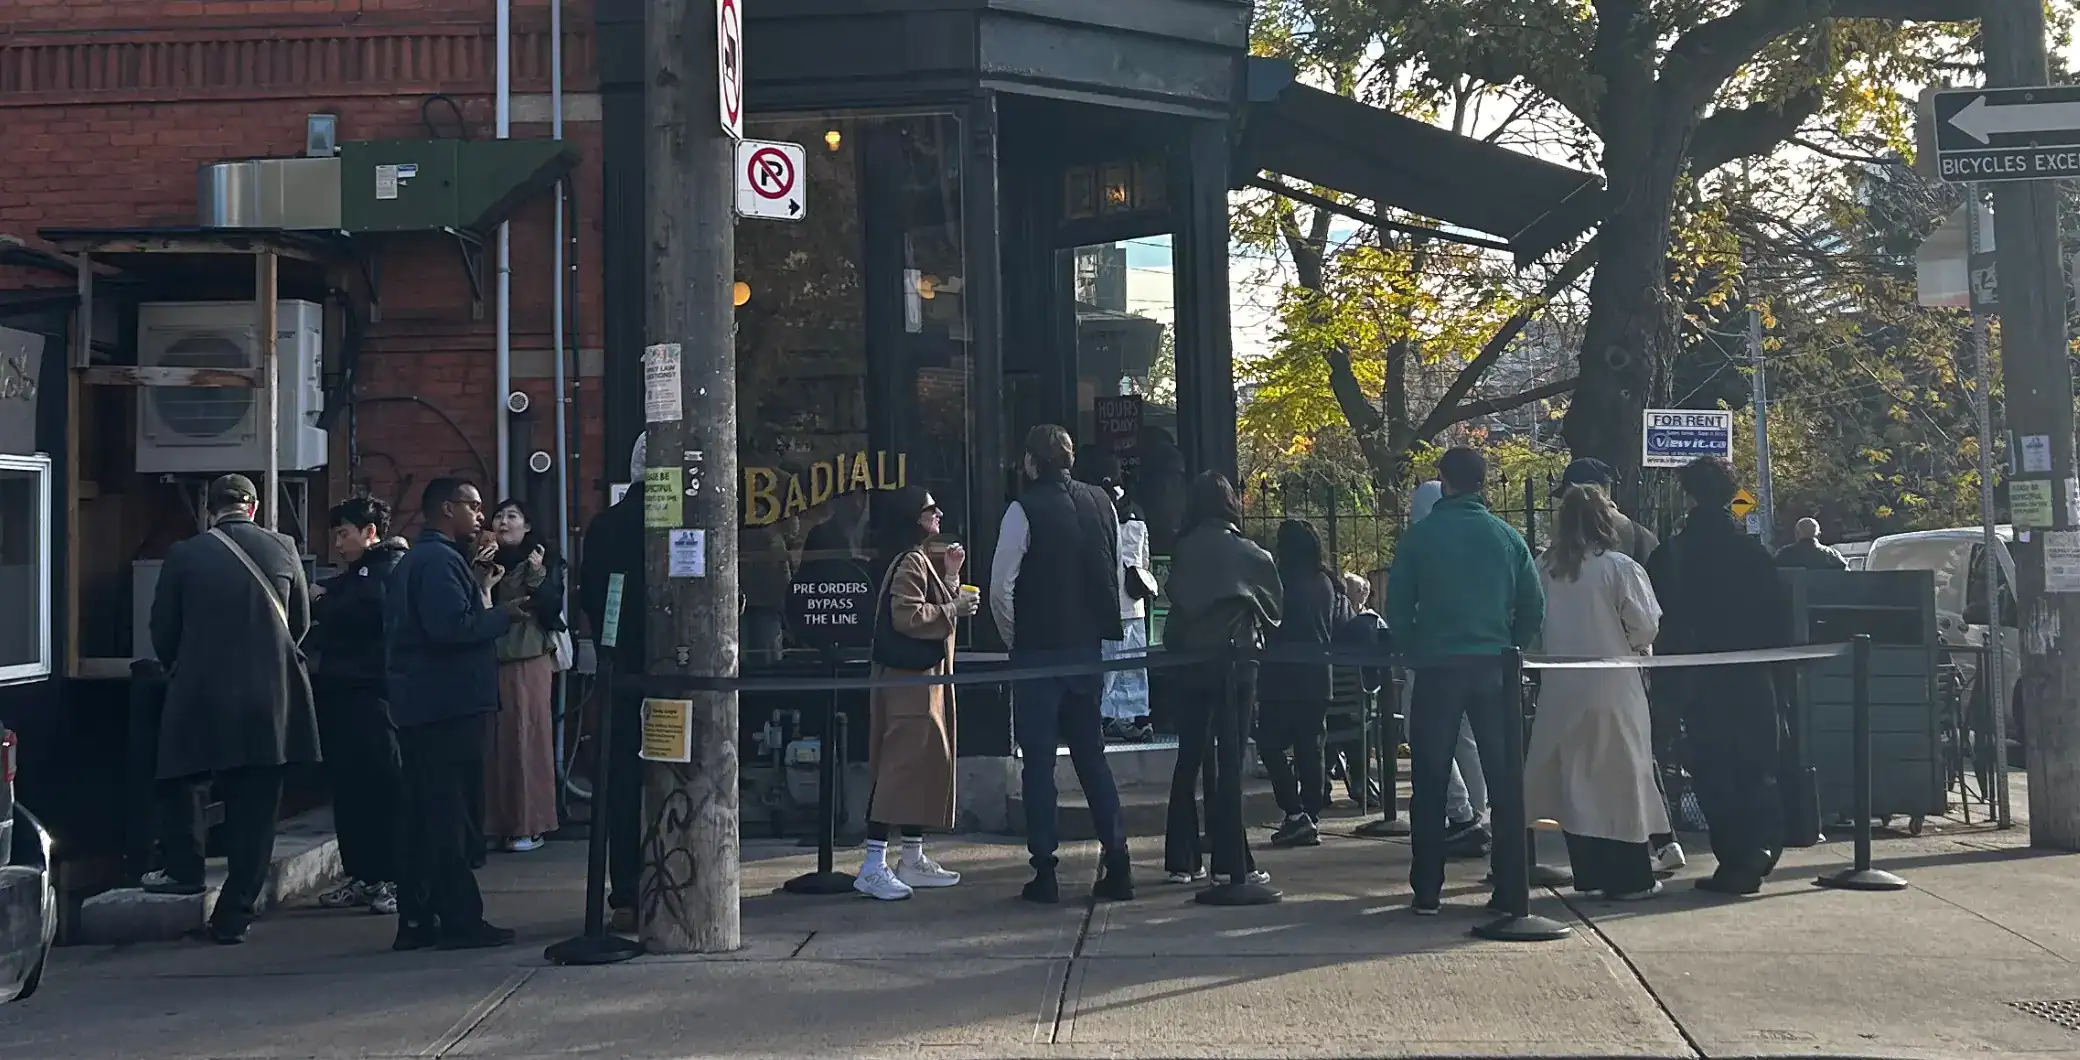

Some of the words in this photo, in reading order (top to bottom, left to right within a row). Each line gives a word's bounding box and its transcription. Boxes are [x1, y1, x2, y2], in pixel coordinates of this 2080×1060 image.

[1942, 155, 2027, 175] BICYCLES
[2035, 152, 2080, 171] EXCE
[1099, 400, 1139, 420] HOURS
[1100, 420, 1109, 433] 7
[1654, 414, 1682, 428] FOR
[1686, 415, 1724, 428] RENT
[744, 450, 907, 526] BADIALI
[793, 583, 816, 594] PRE
[818, 582, 868, 594] ORDERS
[807, 598, 853, 610] BYPASS
[803, 613, 828, 625] THE
[831, 613, 858, 625] LINE
